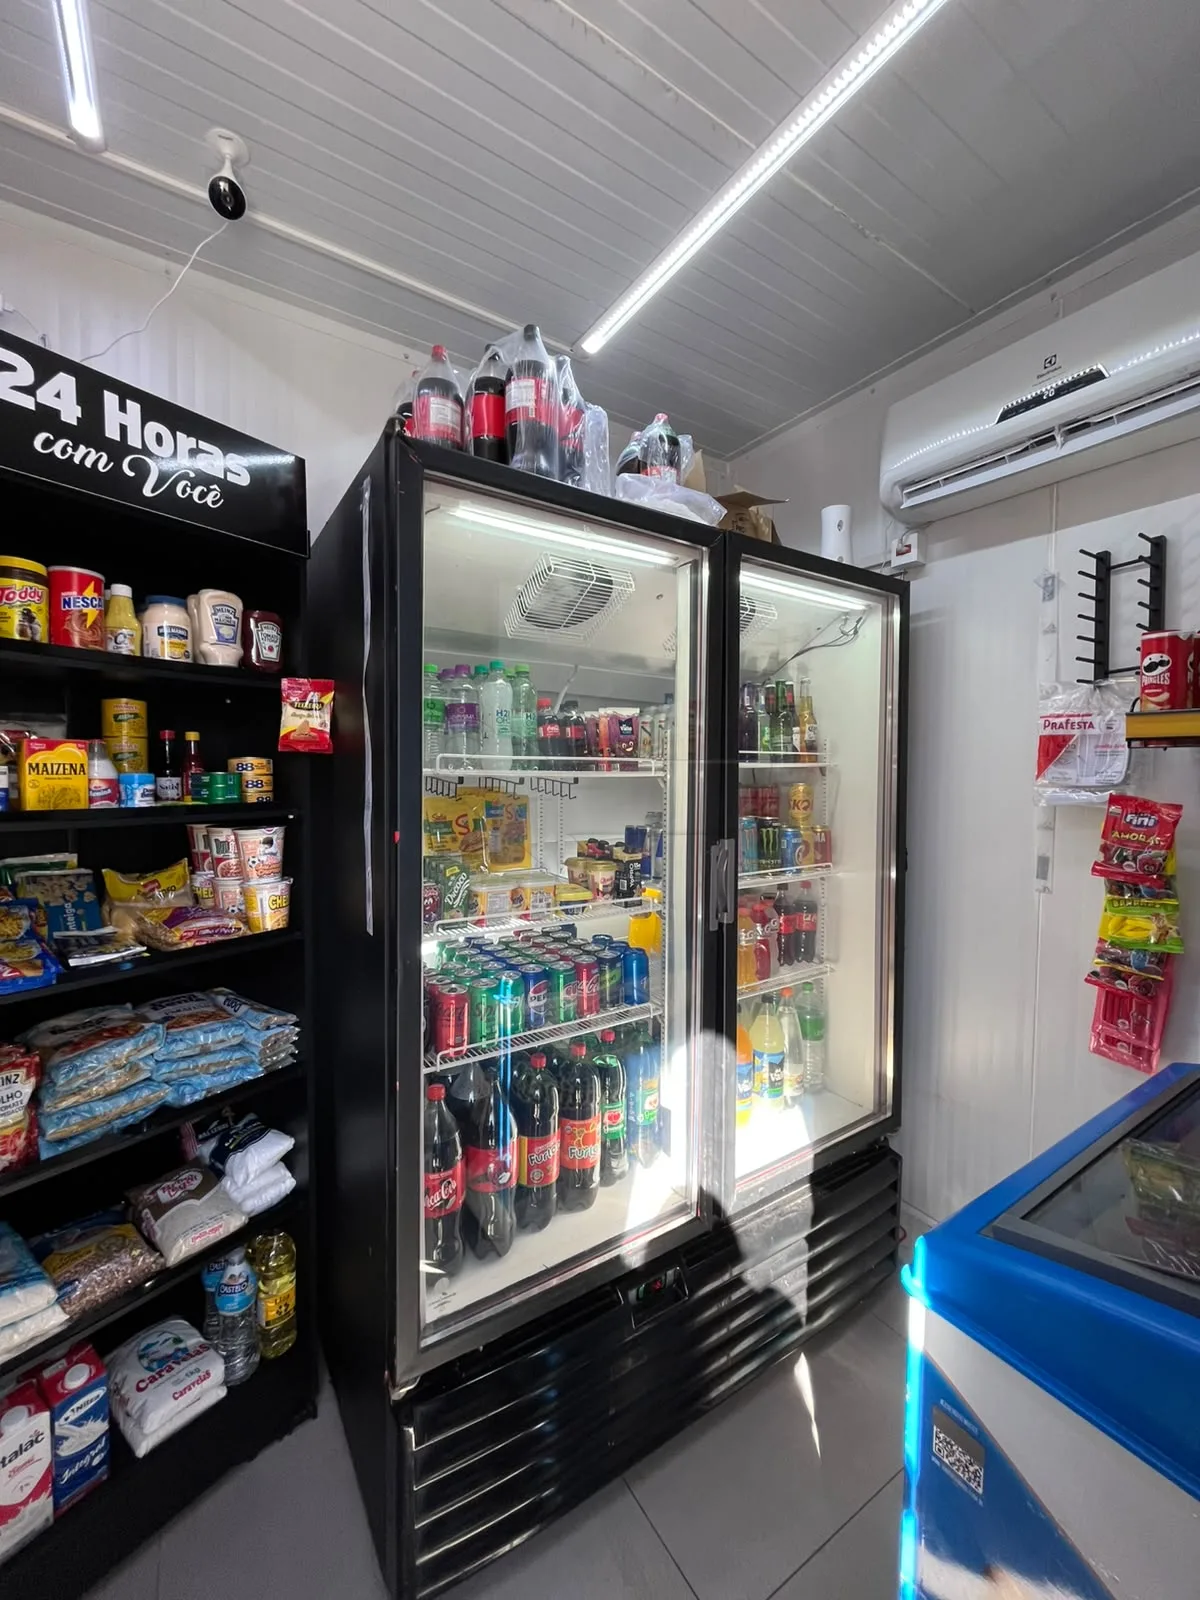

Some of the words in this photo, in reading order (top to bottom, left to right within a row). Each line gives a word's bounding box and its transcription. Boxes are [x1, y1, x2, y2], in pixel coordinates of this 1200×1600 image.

[1043, 388, 1055, 400] 20
[0, 347, 82, 427] 24
[103, 389, 251, 487] Horas
[33, 432, 114, 473] com
[122, 454, 224, 508] Você
[1142, 672, 1170, 687] PRINGLES
[27, 762, 86, 776] MAIZENA
[236, 763, 254, 772] 88
[245, 780, 264, 789] 88
